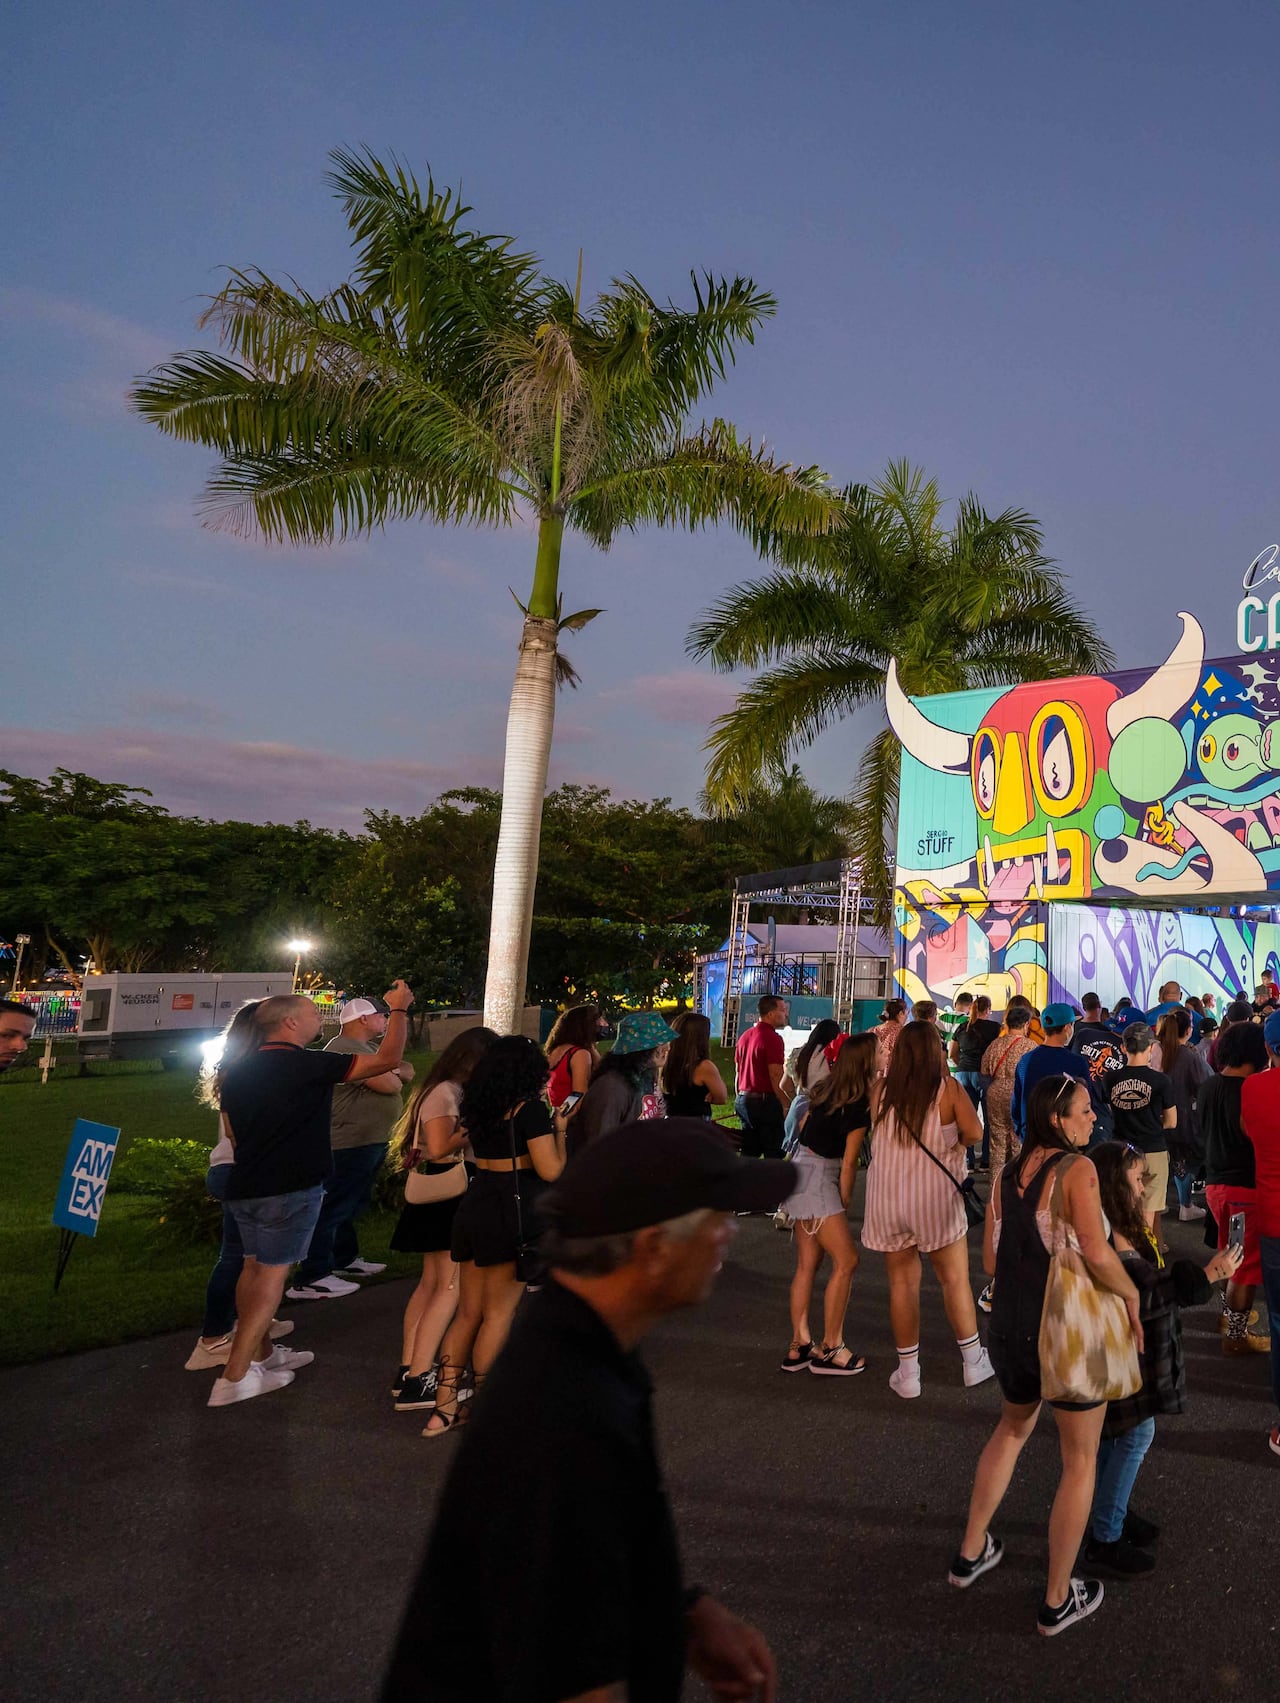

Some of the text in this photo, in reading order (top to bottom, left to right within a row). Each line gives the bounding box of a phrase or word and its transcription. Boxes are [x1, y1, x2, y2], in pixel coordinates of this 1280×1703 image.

[917, 836, 955, 856] STUFF
[926, 830, 948, 838] SERGIO
[72, 1139, 116, 1182] AM
[68, 1177, 107, 1220] EX
